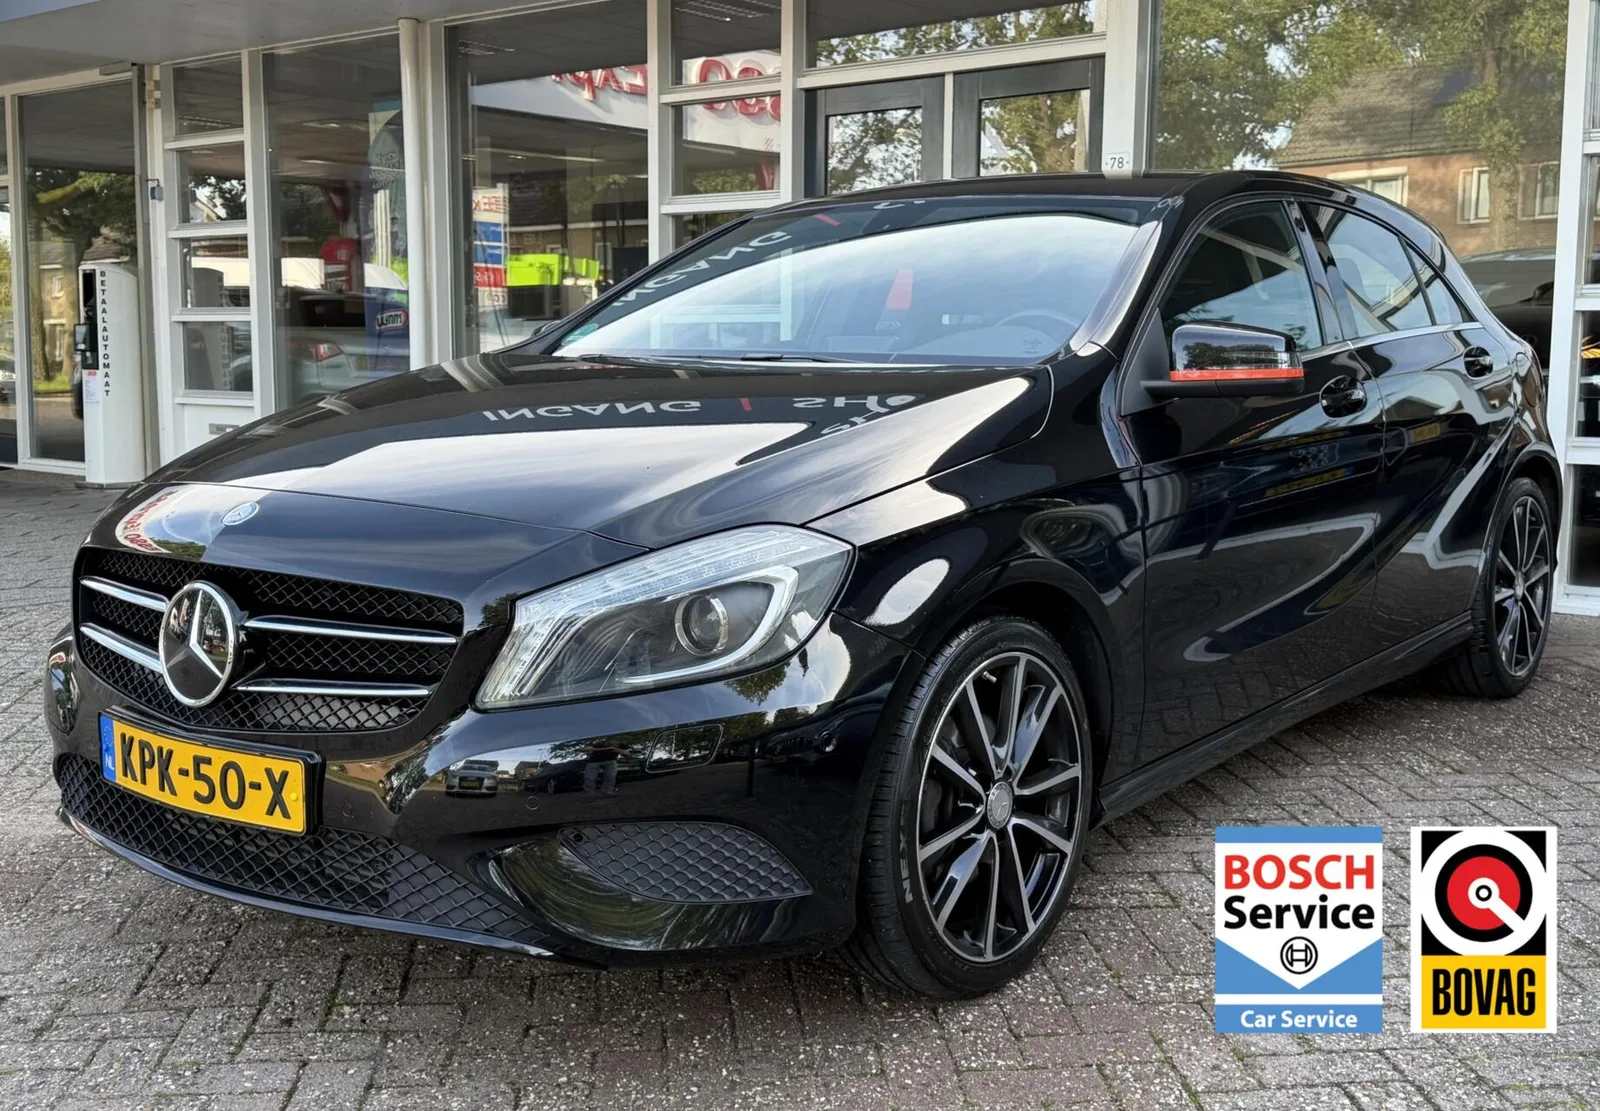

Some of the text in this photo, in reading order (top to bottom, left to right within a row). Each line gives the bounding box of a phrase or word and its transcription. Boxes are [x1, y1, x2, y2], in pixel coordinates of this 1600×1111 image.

[100, 270, 110, 396] BETAALAUTOMAAT
[105, 755, 114, 771] NL
[119, 732, 291, 820] KPK-50-X
